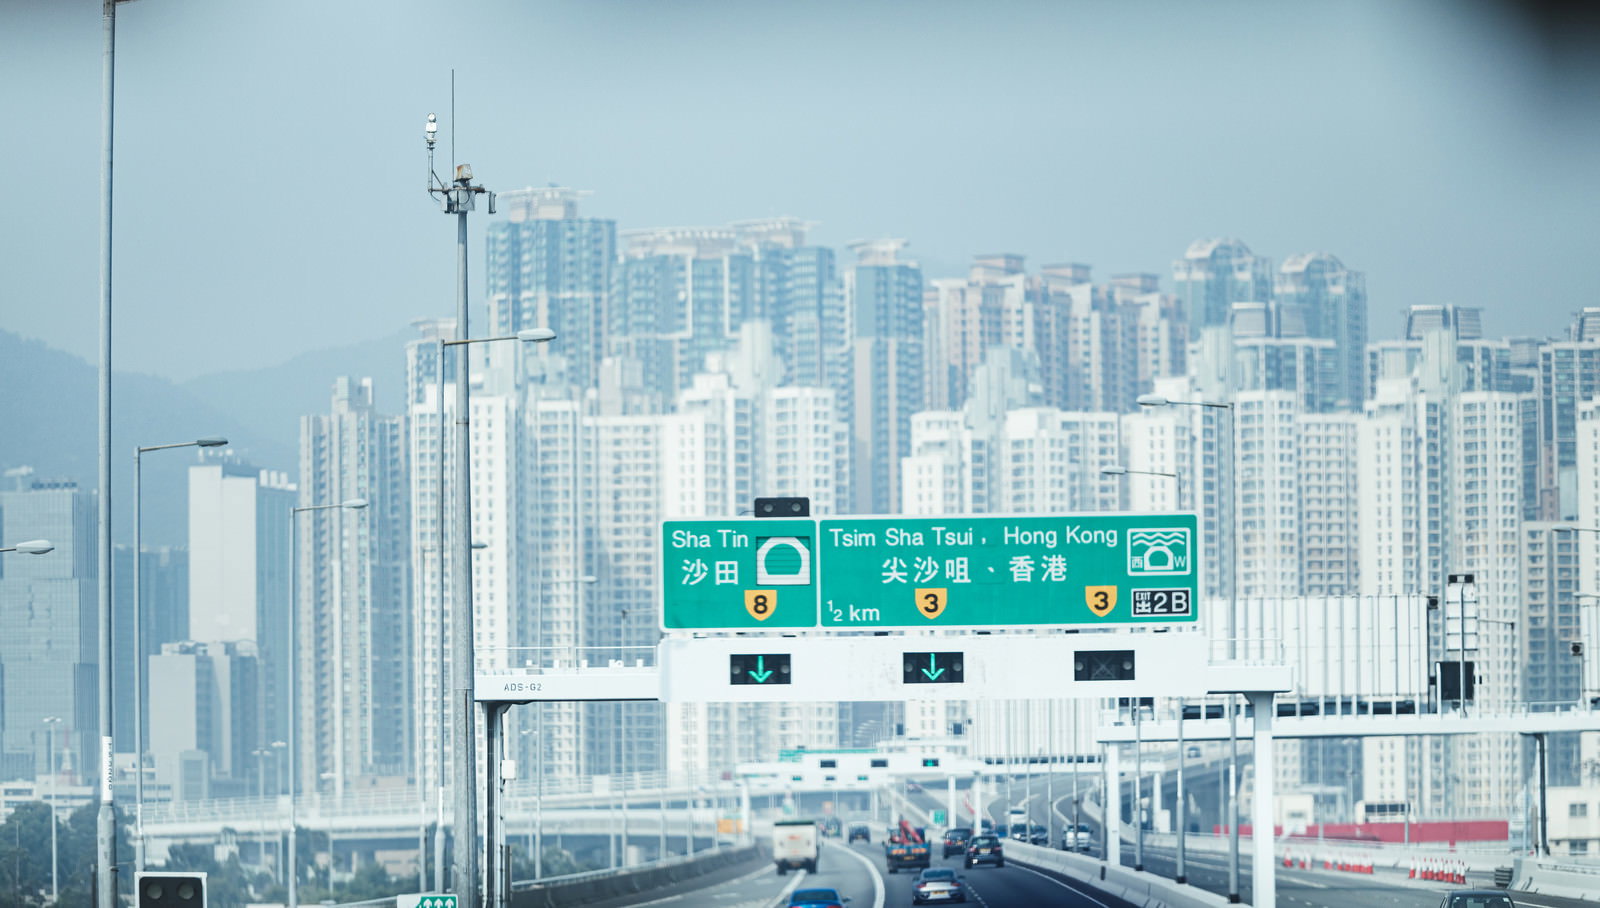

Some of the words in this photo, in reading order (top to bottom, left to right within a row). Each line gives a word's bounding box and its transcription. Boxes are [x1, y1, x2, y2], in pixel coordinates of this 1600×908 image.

[672, 530, 711, 548] Sha
[717, 529, 748, 548] Tin
[829, 528, 876, 547] Tsim
[885, 527, 924, 546] Sha
[1004, 526, 1057, 549] Hong
[1066, 525, 1117, 547] Kong
[1174, 555, 1186, 568] W
[681, 558, 739, 585] 沙田
[753, 594, 768, 614] 8
[924, 593, 939, 613] 3
[1094, 591, 1109, 611] 3
[1135, 592, 1151, 601] EXIT
[849, 604, 880, 621] km
[503, 682, 543, 692] ADS-G2
